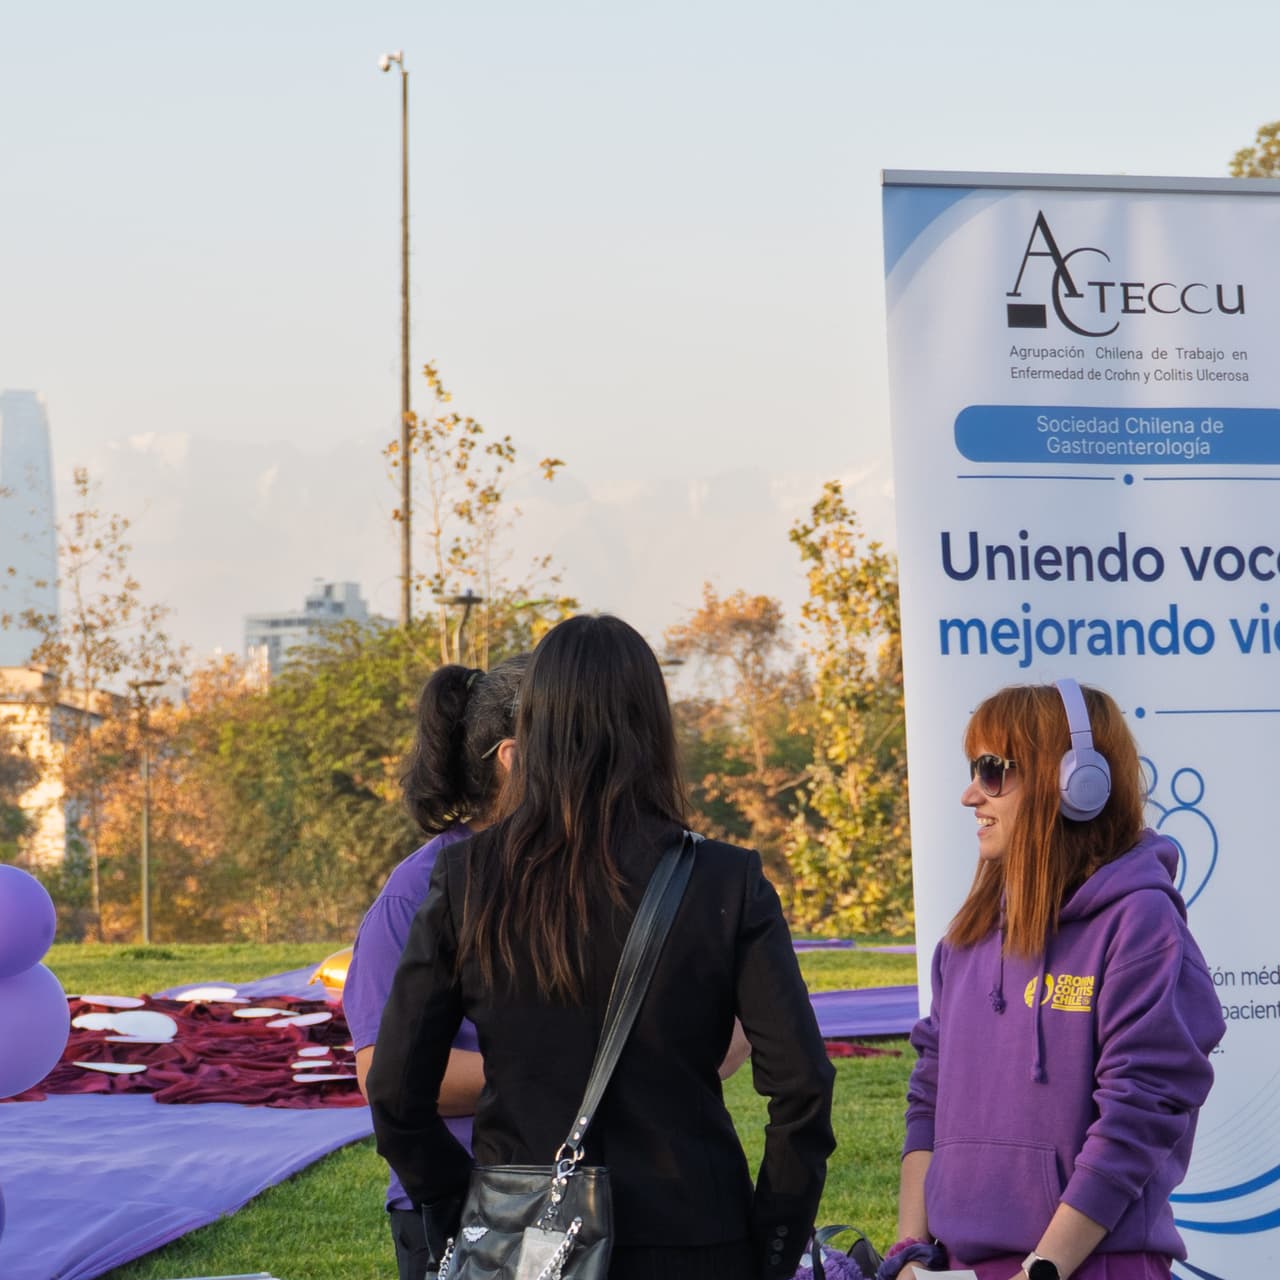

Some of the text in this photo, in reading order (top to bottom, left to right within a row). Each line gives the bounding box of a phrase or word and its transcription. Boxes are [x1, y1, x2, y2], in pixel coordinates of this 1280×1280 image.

[1009, 345, 1248, 363] Agrupación Chilena de Trabajo en
[1010, 366, 1249, 384] Enfermedad de Crohn y Colitis Ulcerosa
[1036, 415, 1224, 434] Sociedad Chilena de
[1046, 436, 1211, 460] Gastroenterología
[940, 529, 1165, 583] Uniendo
[939, 602, 1216, 668] mejorando
